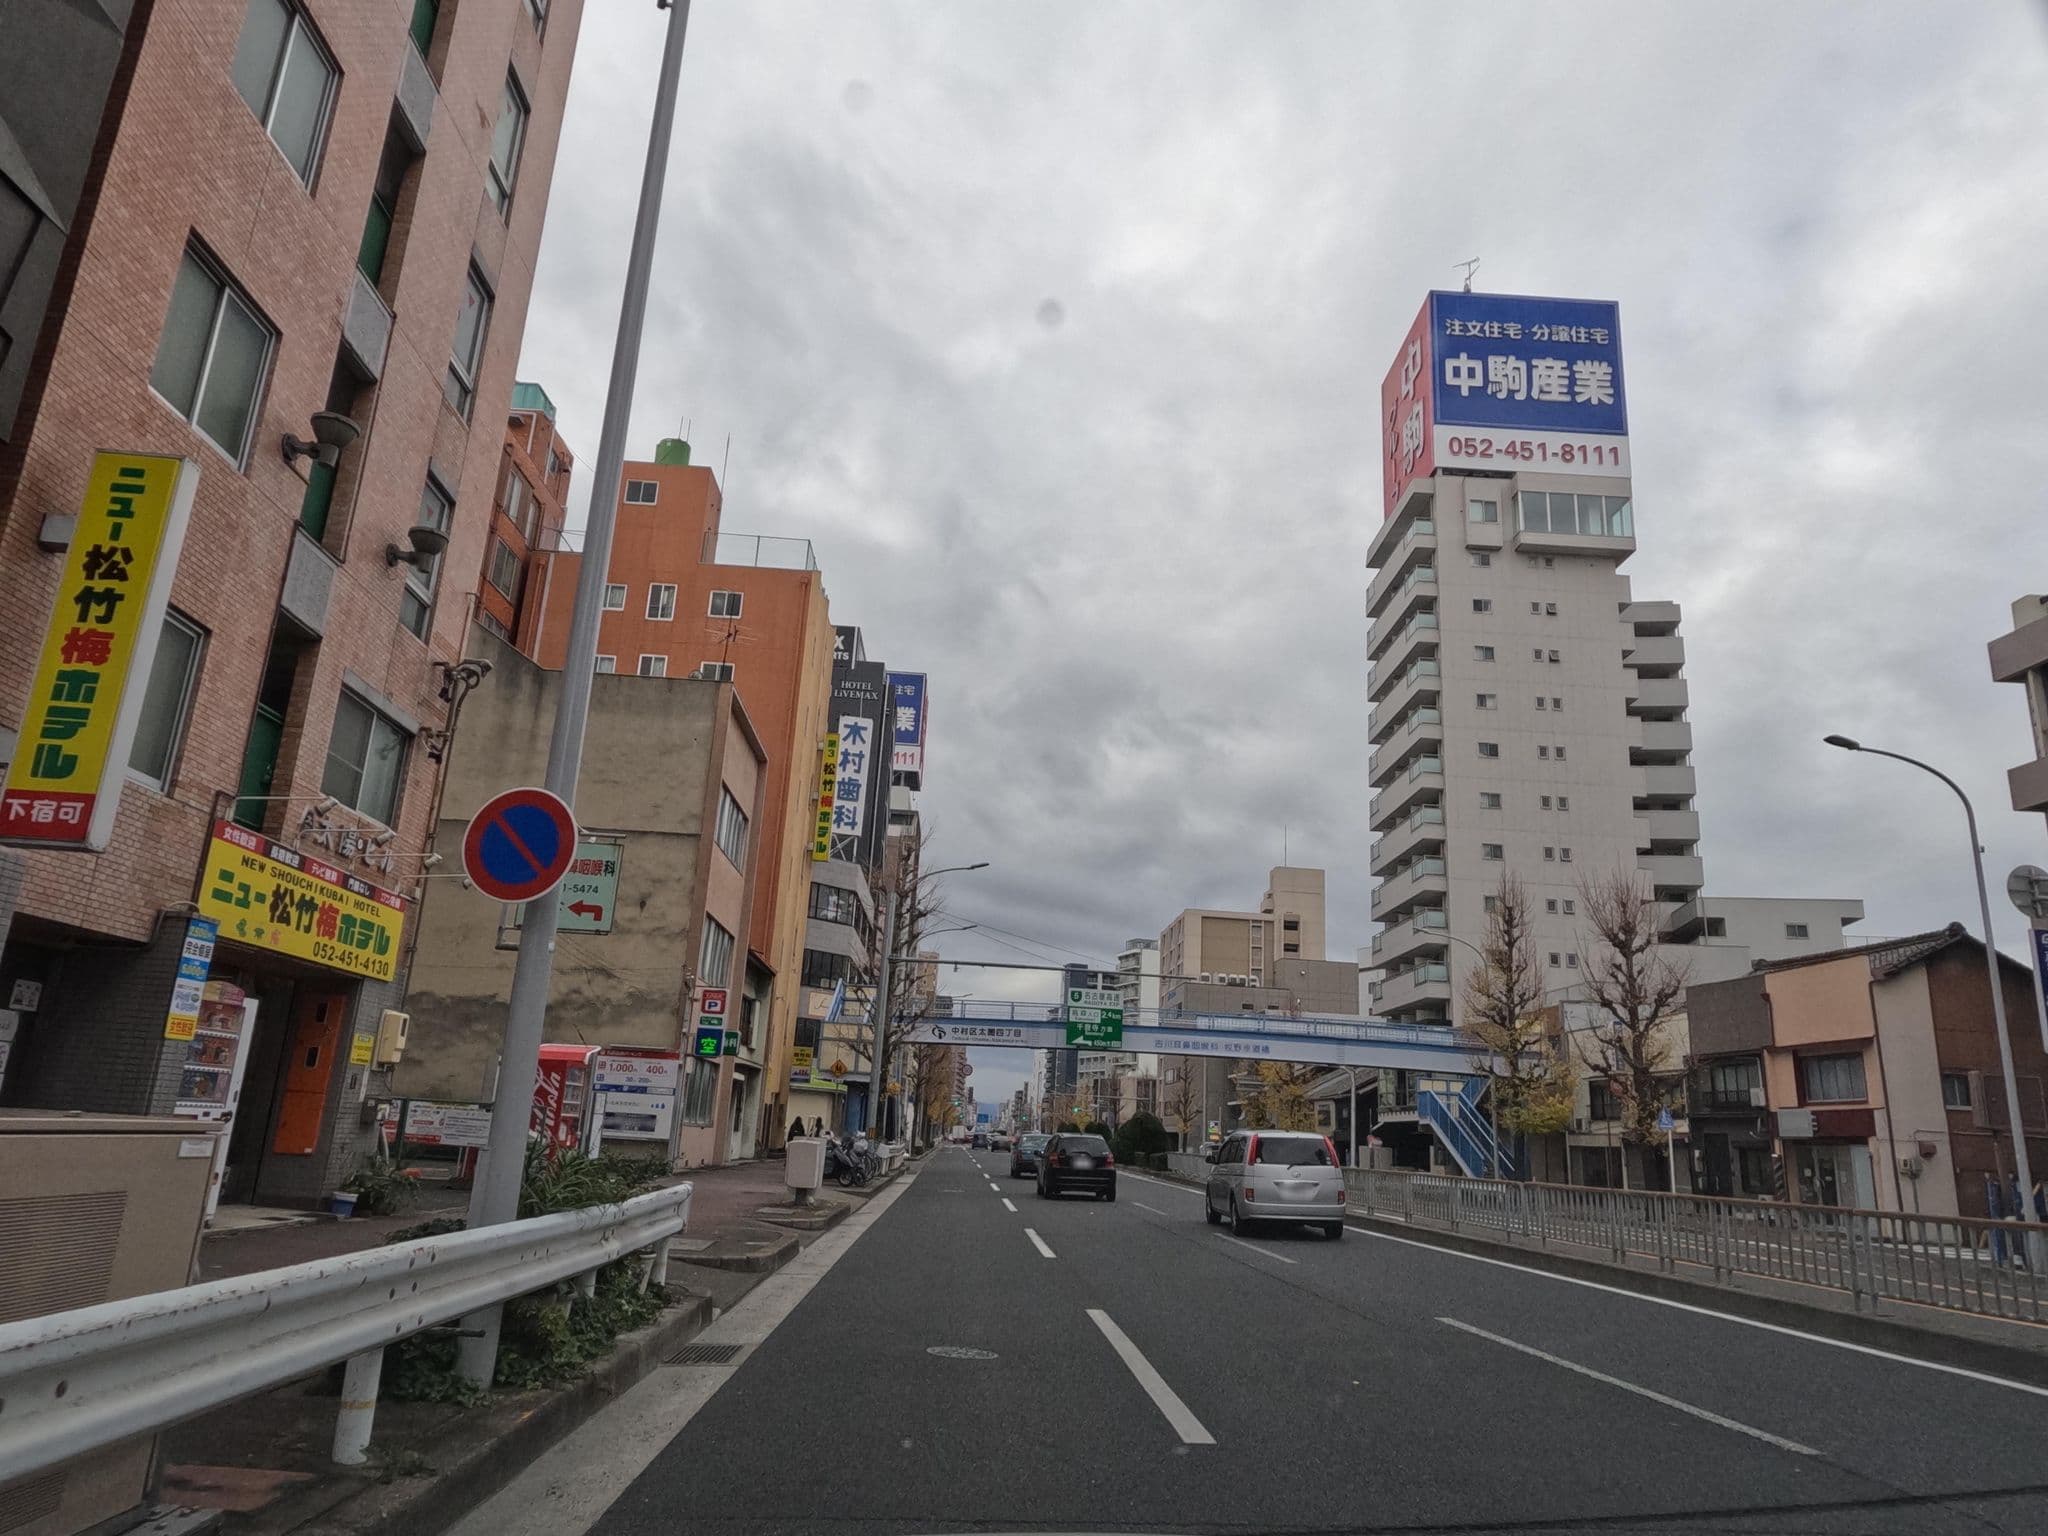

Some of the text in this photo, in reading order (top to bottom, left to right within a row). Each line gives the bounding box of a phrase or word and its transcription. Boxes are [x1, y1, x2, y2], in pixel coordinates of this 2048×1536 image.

[1444, 351, 1615, 405] 中駒産業
[1448, 436, 1620, 466] 052-451-8111
[30, 467, 146, 780] ニュー松竹梅ホテル
[841, 680, 873, 690] HOTEL
[896, 705, 916, 732] 業
[833, 722, 868, 831] 木村歯科
[7, 798, 86, 826] 下宿可
[241, 854, 267, 874] NEW
[270, 866, 350, 906] SHOUCHIKUBAI
[353, 899, 382, 918] HOTEL
[211, 868, 391, 957] ニュー松竹梅ホテル
[312, 941, 390, 977] 052-451-4130
[708, 1001, 718, 1010] P
